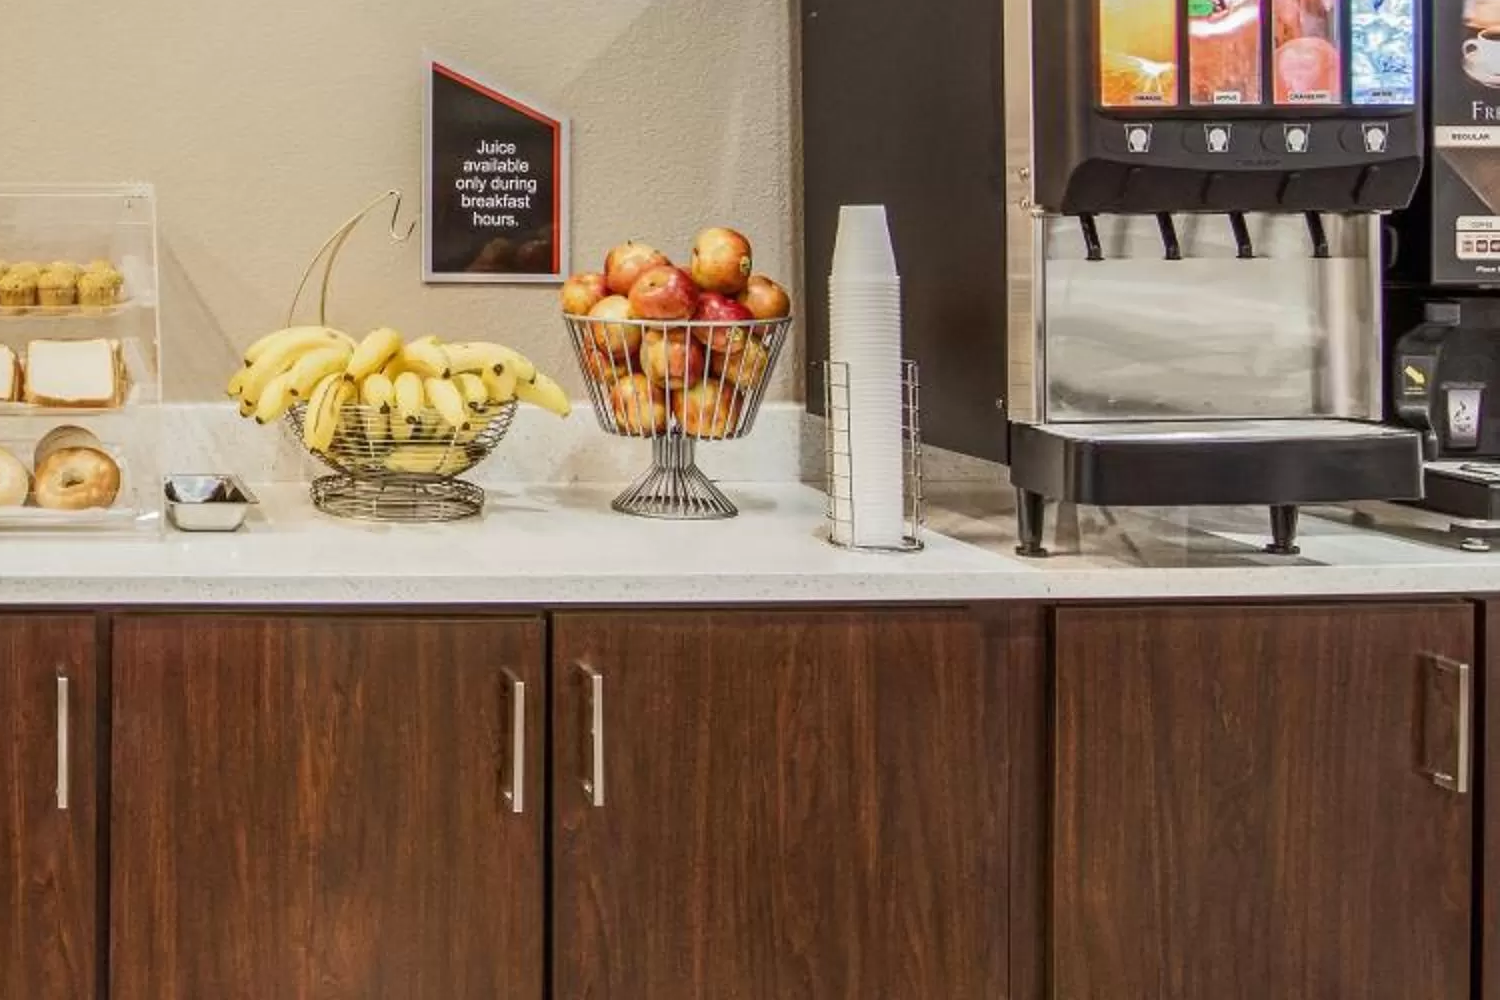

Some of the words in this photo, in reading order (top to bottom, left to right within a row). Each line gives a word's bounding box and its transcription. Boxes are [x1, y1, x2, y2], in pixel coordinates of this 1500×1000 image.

[1451, 133, 1490, 141] REGULAR
[476, 139, 516, 154] Juice
[463, 158, 530, 173] available
[455, 176, 487, 193] only
[490, 176, 537, 193] during
[461, 193, 531, 209] breakfast
[473, 211, 519, 227] hours.
